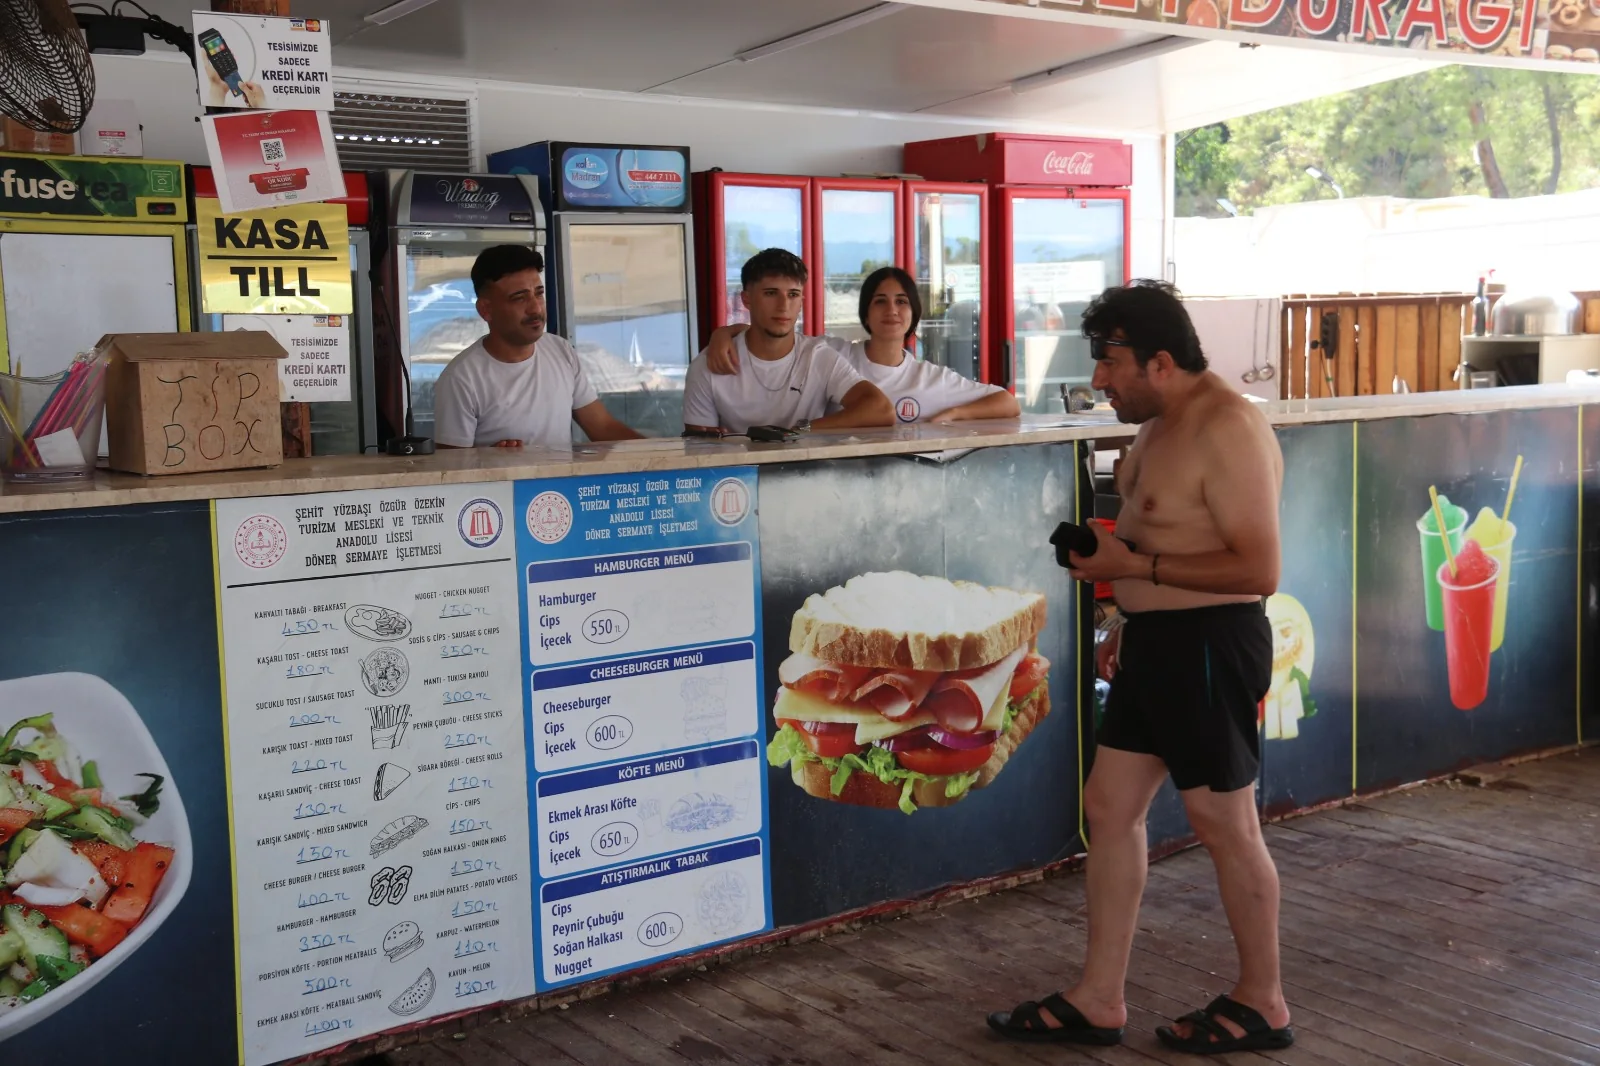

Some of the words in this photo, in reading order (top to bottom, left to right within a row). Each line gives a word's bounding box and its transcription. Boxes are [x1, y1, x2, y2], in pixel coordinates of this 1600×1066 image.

[267, 41, 319, 52] TESİSİMİZDE
[278, 57, 310, 66] SADECE
[262, 69, 294, 81] KREDİ
[297, 71, 328, 82] KARTI
[272, 84, 321, 95] GEÇERLİDİR
[0, 169, 76, 200] fuse
[436, 179, 500, 211] Uludağ
[215, 218, 329, 249] KASA
[230, 267, 320, 297] TILL
[291, 336, 338, 347] TESİSİMİZDE
[300, 351, 330, 360] SADECE
[284, 363, 314, 375] KREDİ
[317, 365, 346, 375] KARTI
[293, 378, 338, 389] GEÇERLİDİR
[162, 418, 263, 467] BOX
[578, 485, 600, 500] ŞEHİT
[608, 482, 640, 496] YÜZBAŞI
[646, 479, 669, 492] ÖZGÜR
[675, 478, 702, 489] ÖZEKİN
[295, 506, 324, 522] ŞEHİT
[333, 502, 372, 518] YÜZBAŞI
[379, 498, 407, 513] ÖZGÜR
[414, 497, 446, 510] ÖZEKİN
[580, 498, 610, 511] TURİZM
[616, 495, 650, 508] MESLEKİ
[656, 494, 667, 505] VE
[673, 492, 701, 503] TEKNİK
[298, 520, 337, 535] TURİZM
[344, 516, 384, 531] MESLEKİ
[393, 516, 404, 527] VE
[411, 512, 445, 526] TEKNİK
[609, 511, 644, 524] ANADOLU
[651, 508, 674, 520] LİSESİ
[335, 533, 378, 548] ANADOLU
[386, 529, 413, 543] LİSESİ
[585, 528, 611, 540] DÖNER
[617, 526, 653, 538] SERMAYE
[659, 521, 698, 536] İŞLETMESİ
[305, 552, 337, 567] DÖNER
[345, 549, 388, 563] SERMAYE
[396, 542, 442, 561] İŞLETMESİ
[594, 556, 660, 574] HAMBURGER
[664, 551, 694, 565] MENÜ
[414, 591, 437, 601] NUGGET
[443, 588, 467, 598] CHICKEN
[468, 586, 490, 595] NUGGET
[539, 591, 597, 607] Hamburger
[254, 609, 283, 619] KAHVALTI
[285, 605, 307, 616] TABAĞI
[313, 602, 347, 613] BREAKFAST
[539, 614, 560, 629] Cips
[590, 618, 613, 636] 550
[615, 625, 621, 634] TL
[540, 632, 572, 650] İçecek
[257, 653, 283, 665] KAŞARLI
[285, 652, 300, 661] TOST
[306, 648, 329, 658] CHEESE
[331, 646, 349, 655] TOAST
[590, 658, 670, 680] CHEESEBURGER
[673, 653, 704, 668] MENÜ
[256, 699, 284, 710] SUCUKLU
[286, 697, 301, 706] TOST
[308, 692, 335, 703] SAUSAGE
[336, 690, 355, 699] TOAST
[543, 694, 612, 716] Cheeseburger
[544, 721, 565, 737] Cips
[594, 724, 617, 743] 600
[618, 730, 625, 739] TL
[262, 744, 287, 755] KARIŞIK
[289, 741, 308, 751] TOAST
[315, 737, 333, 747] MIXED
[335, 734, 354, 743] TOAST
[545, 738, 576, 757] İçecek
[618, 763, 651, 780] KÖFTE
[655, 757, 685, 773] MENÜ
[258, 790, 285, 802] KAŞARLI
[286, 783, 312, 795] SANDVİÇ
[319, 781, 341, 791] CHEESE
[343, 776, 362, 786] TOAST
[464, 798, 481, 807] CHIPS
[548, 805, 582, 824] Ekmek
[584, 803, 609, 817] Arası
[610, 796, 637, 812] Köfte
[256, 835, 282, 847] KARIŞIK
[283, 829, 310, 842] SANDVİÇ
[316, 825, 335, 835] MIXED
[336, 820, 368, 831] SANDWICH
[549, 829, 570, 845] Cips
[600, 830, 622, 850] 650
[623, 836, 630, 845] TL
[550, 846, 581, 864] İçecek
[263, 879, 286, 890] CHEESE
[288, 874, 312, 885] BURGER
[318, 869, 341, 879] CHEESE
[342, 863, 366, 874] BURGER
[601, 860, 671, 885] ATIŞTIRMALIK
[676, 851, 709, 869] TABAK
[413, 892, 429, 902] ELMA
[446, 883, 469, 895] PATATES
[474, 878, 495, 889] POTATO
[496, 873, 518, 884] WEDGES
[276, 919, 314, 932] HAMBURGER
[320, 909, 357, 923] HAMBURGER
[551, 903, 572, 919] Cips
[436, 928, 459, 939] KARPUZ
[463, 919, 500, 932] WATERMELON
[552, 919, 585, 937] Peynir
[586, 910, 624, 930] Çubuğu
[645, 921, 667, 940] 600
[669, 926, 676, 934] TL
[553, 938, 585, 957] Soğan
[586, 931, 623, 948] Halkası
[258, 968, 290, 982] PORSİYON
[291, 963, 310, 974] KÖFTE
[317, 955, 343, 968] PORTION
[344, 947, 377, 961] MEATBALLS
[448, 967, 467, 978] KAVUN
[472, 962, 491, 972] MELON
[555, 957, 592, 976] Nugget
[257, 1016, 279, 1028] EKMEK
[280, 1010, 300, 1021] ARASI
[300, 1006, 320, 1017] KÖFTE
[326, 996, 356, 1010] MEATBALL
[357, 990, 382, 1002] SANDVİÇ
